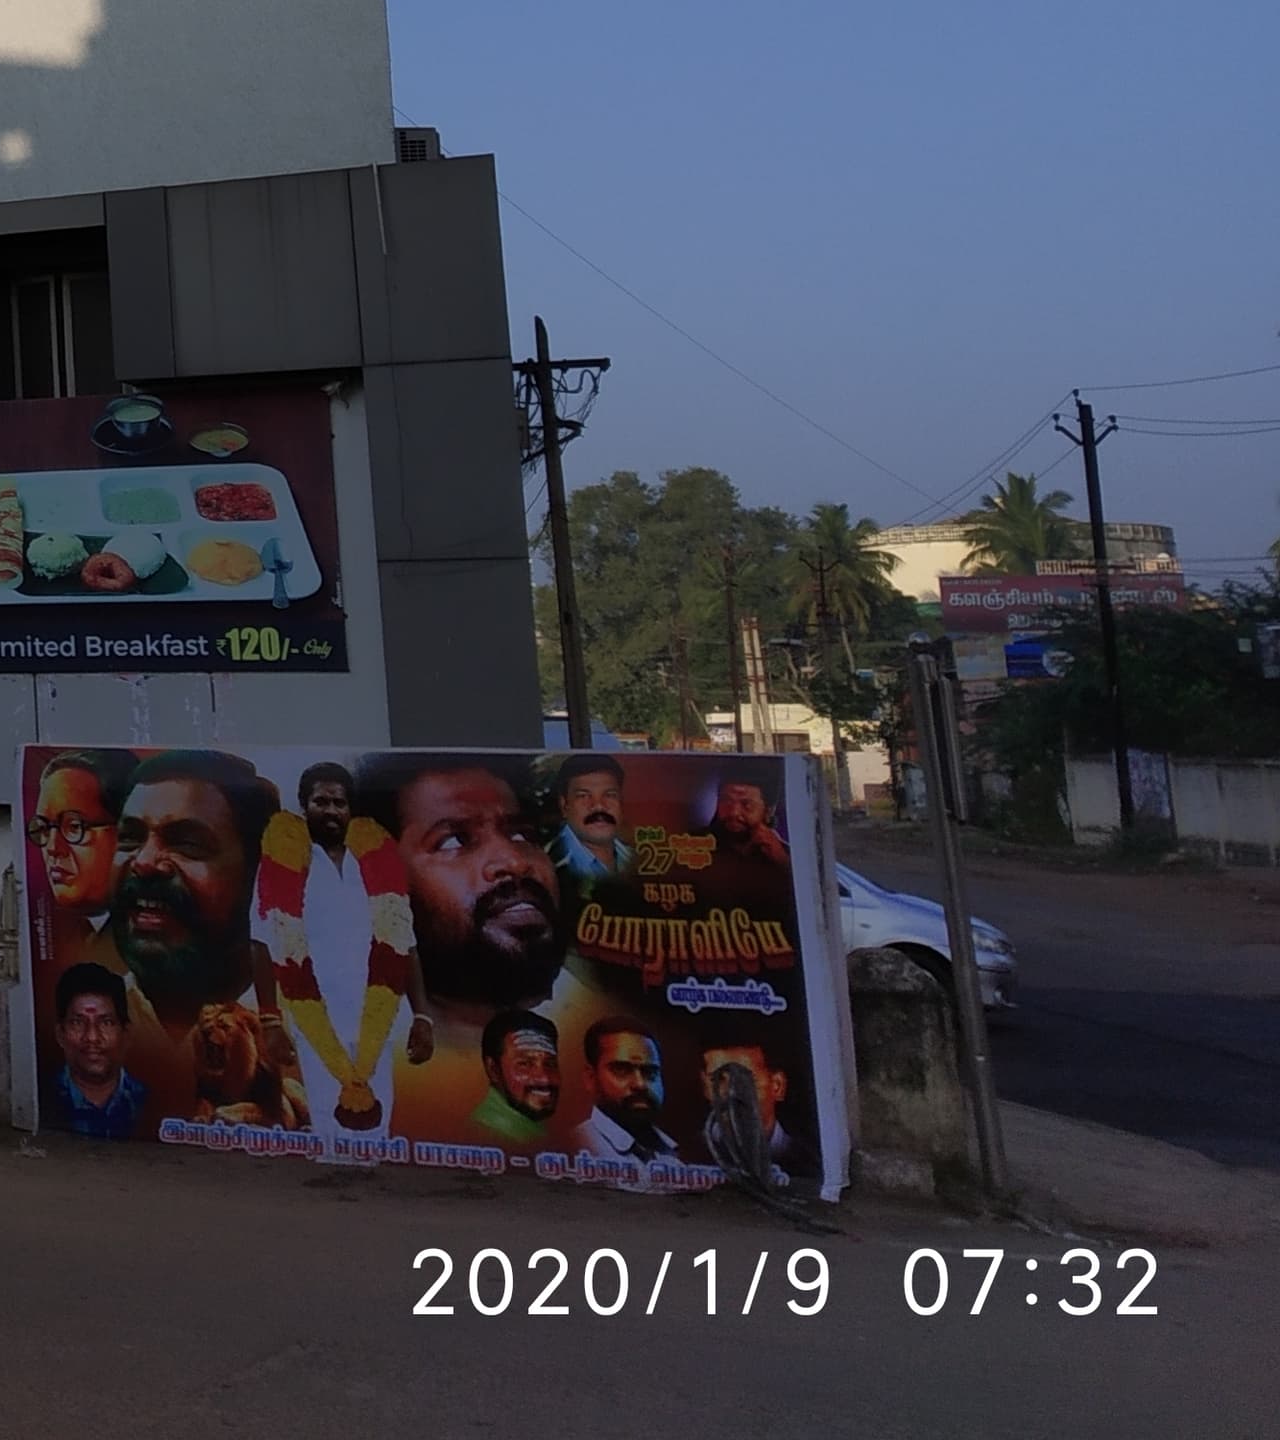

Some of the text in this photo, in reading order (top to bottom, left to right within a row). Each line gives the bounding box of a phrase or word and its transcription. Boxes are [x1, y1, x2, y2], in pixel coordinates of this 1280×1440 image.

[86, 633, 210, 657] Breakfast
[303, 639, 334, 660] Only
[637, 842, 676, 875] 27
[643, 882, 696, 909] கழக
[577, 902, 794, 984] போராளியே
[160, 1118, 324, 1159] இளஞ்சிறுத்தை
[334, 1135, 407, 1164] எழுச்சி
[414, 1143, 504, 1176] பாசறை
[536, 1151, 640, 1184] குடந்தை
